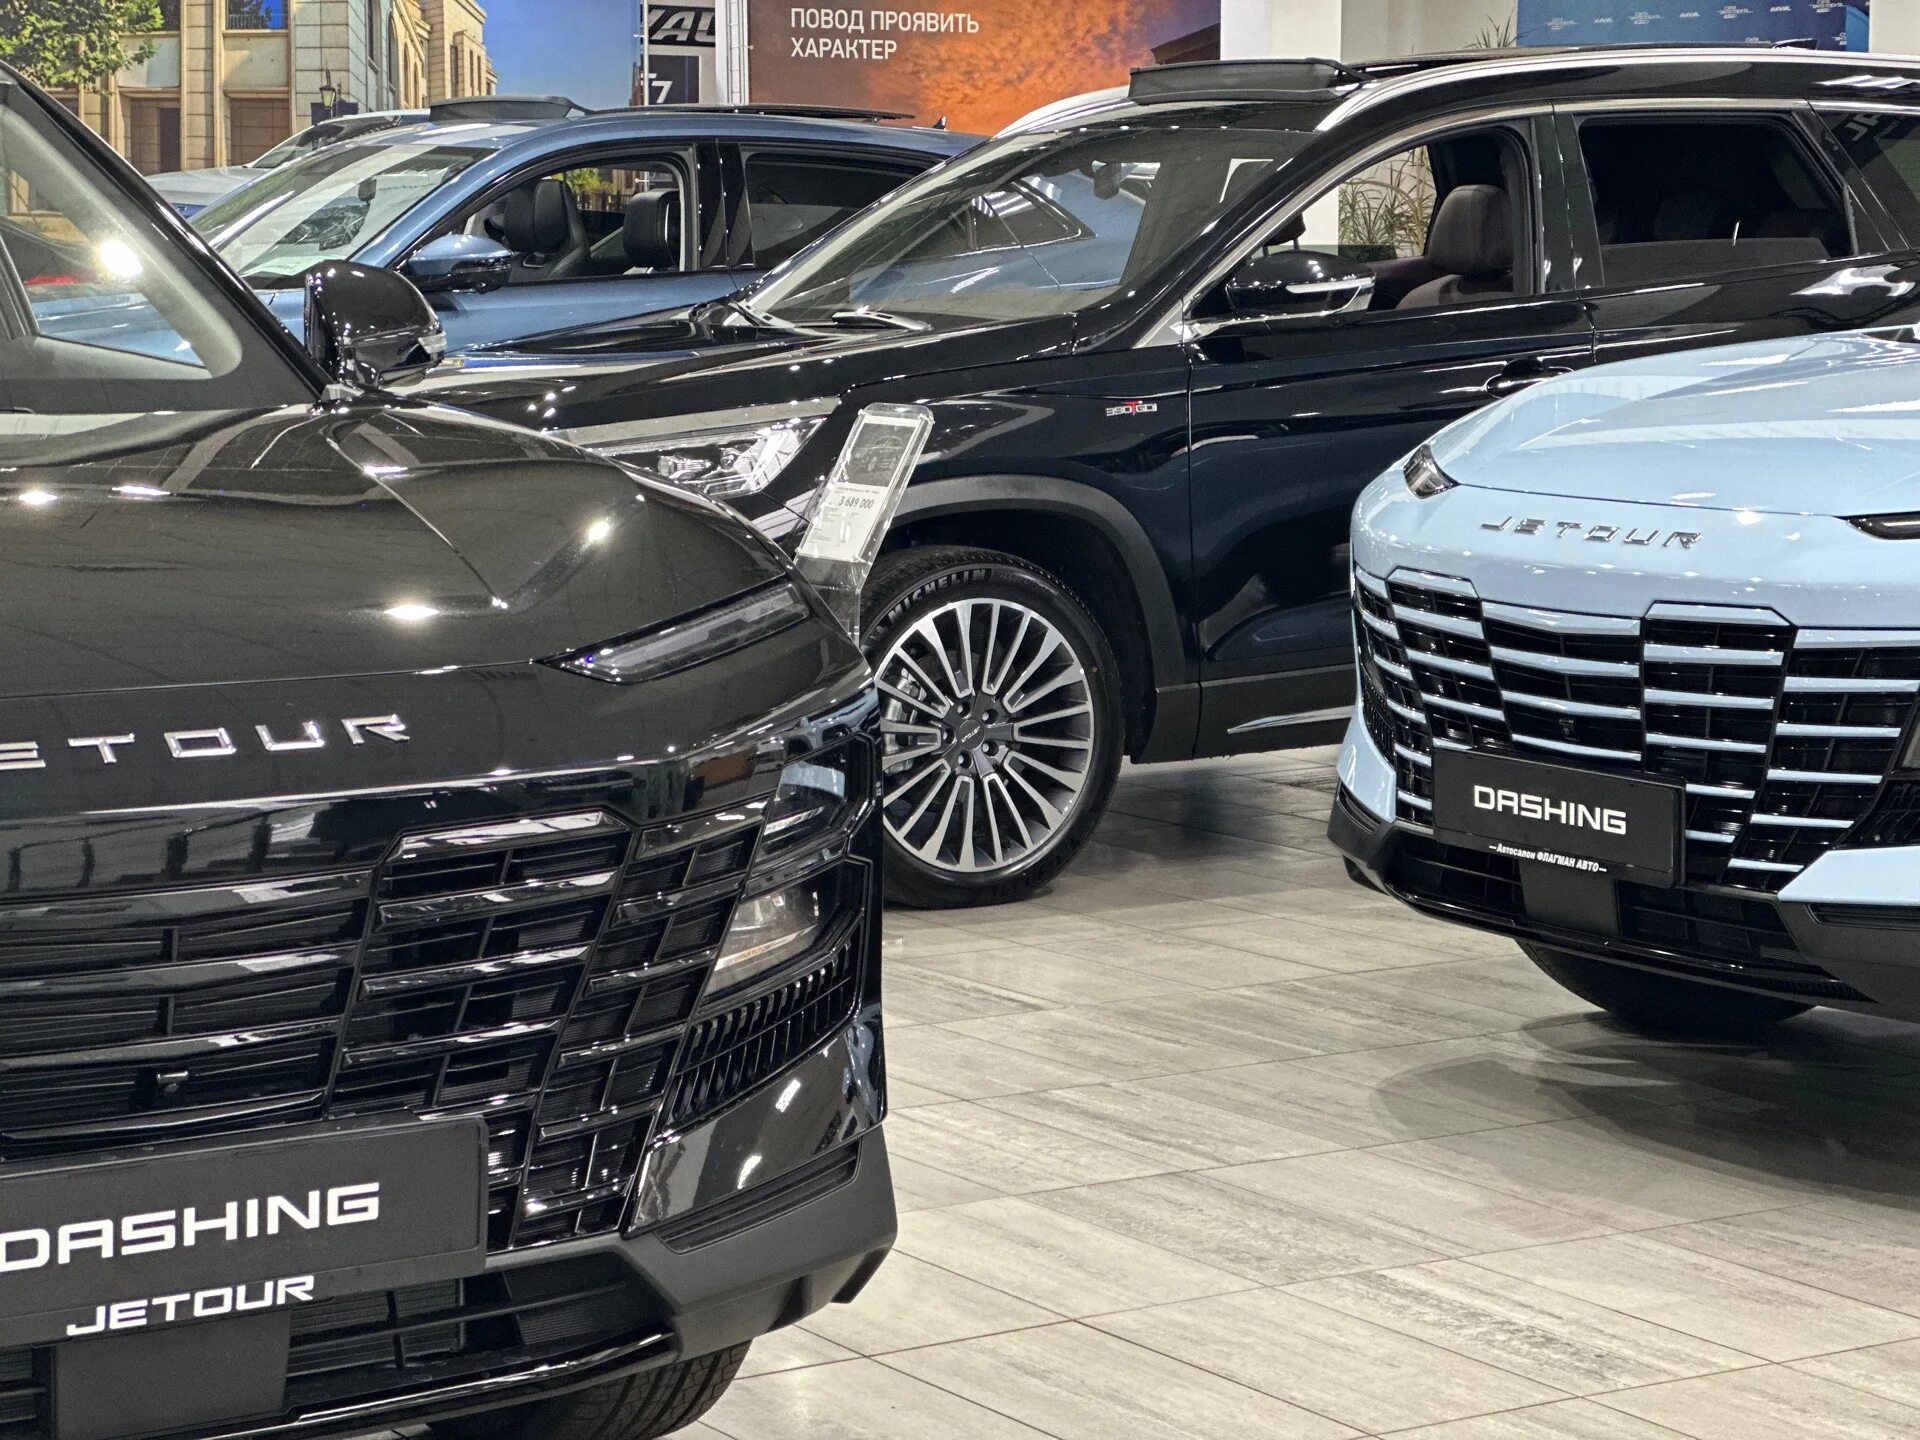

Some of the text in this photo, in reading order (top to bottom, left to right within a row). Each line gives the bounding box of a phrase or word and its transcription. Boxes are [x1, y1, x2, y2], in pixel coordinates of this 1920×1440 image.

[791, 8, 980, 33] ПОВОД ПРОЯВИТЬ
[790, 37, 898, 60] ХАРАКТЕР
[1480, 515, 1702, 550] JETOUR
[0, 713, 411, 770] ETOUR
[1473, 784, 1627, 835] DASHING
[1536, 851, 1576, 868] ФЛАГМАН
[0, 1182, 381, 1274] DASHING
[66, 1274, 315, 1337] JETOUR
